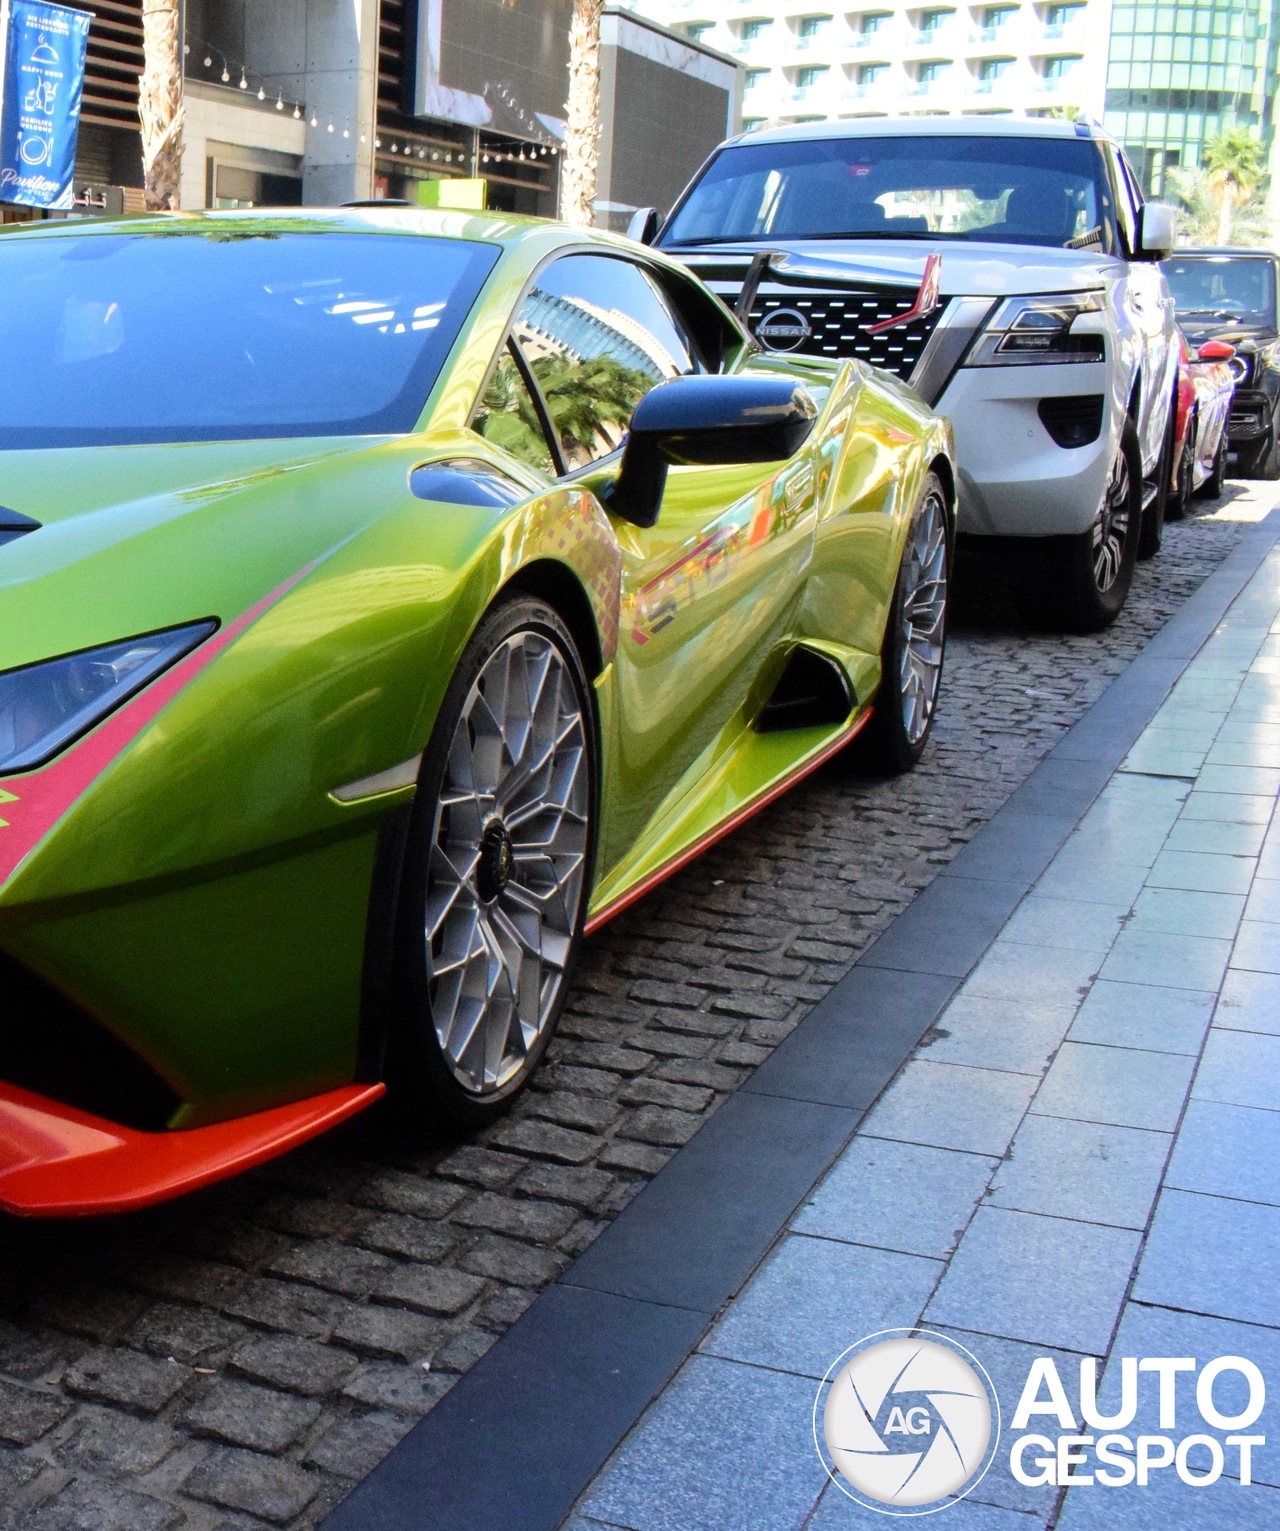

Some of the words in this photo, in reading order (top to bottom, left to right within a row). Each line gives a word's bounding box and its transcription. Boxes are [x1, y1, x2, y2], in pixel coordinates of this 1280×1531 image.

[21, 65, 43, 74] HAPPY
[44, 69, 64, 79] HOUR
[21, 116, 53, 127] FAMILIES
[1, 168, 60, 192] Pavilion
[755, 327, 811, 336] NISSAN
